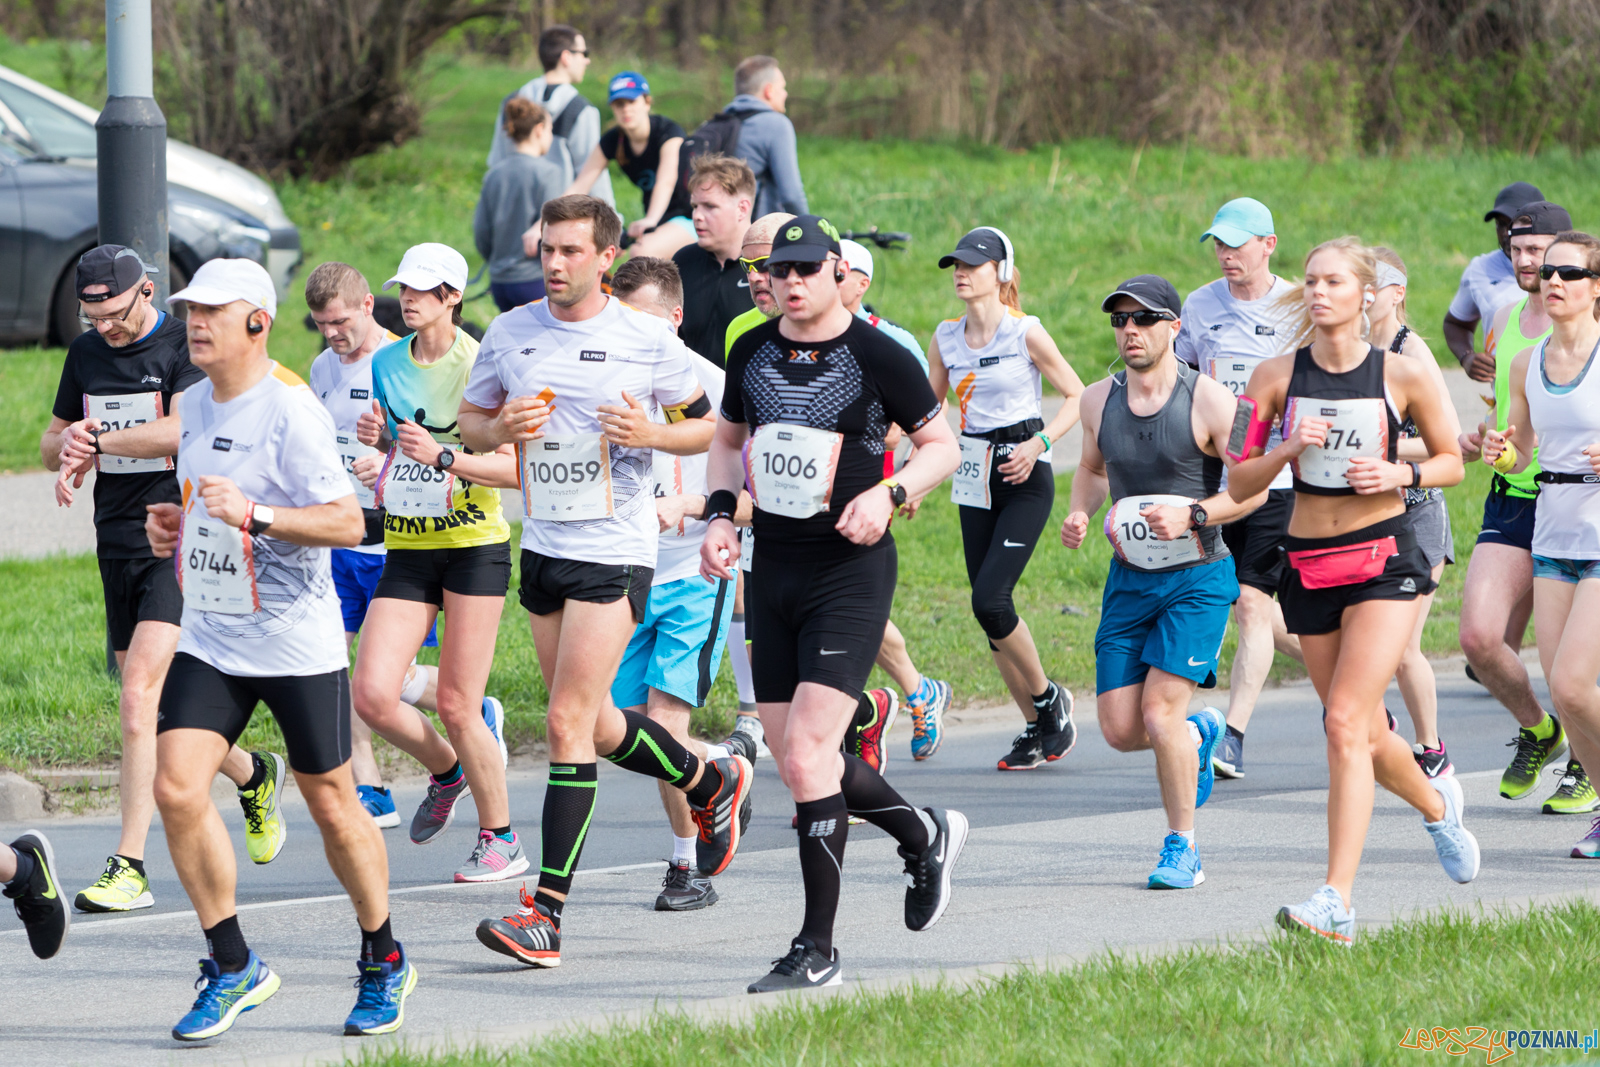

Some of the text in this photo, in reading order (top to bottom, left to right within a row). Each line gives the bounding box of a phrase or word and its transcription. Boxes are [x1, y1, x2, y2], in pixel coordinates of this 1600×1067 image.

[520, 347, 537, 356] 4F
[763, 452, 817, 480] 1006
[1323, 455, 1351, 463] Martyn
[392, 463, 446, 483] 12065
[529, 460, 601, 485] 10059
[548, 488, 579, 496] Krzysztof
[774, 480, 800, 490] Zbigniew
[189, 547, 238, 576] 6744
